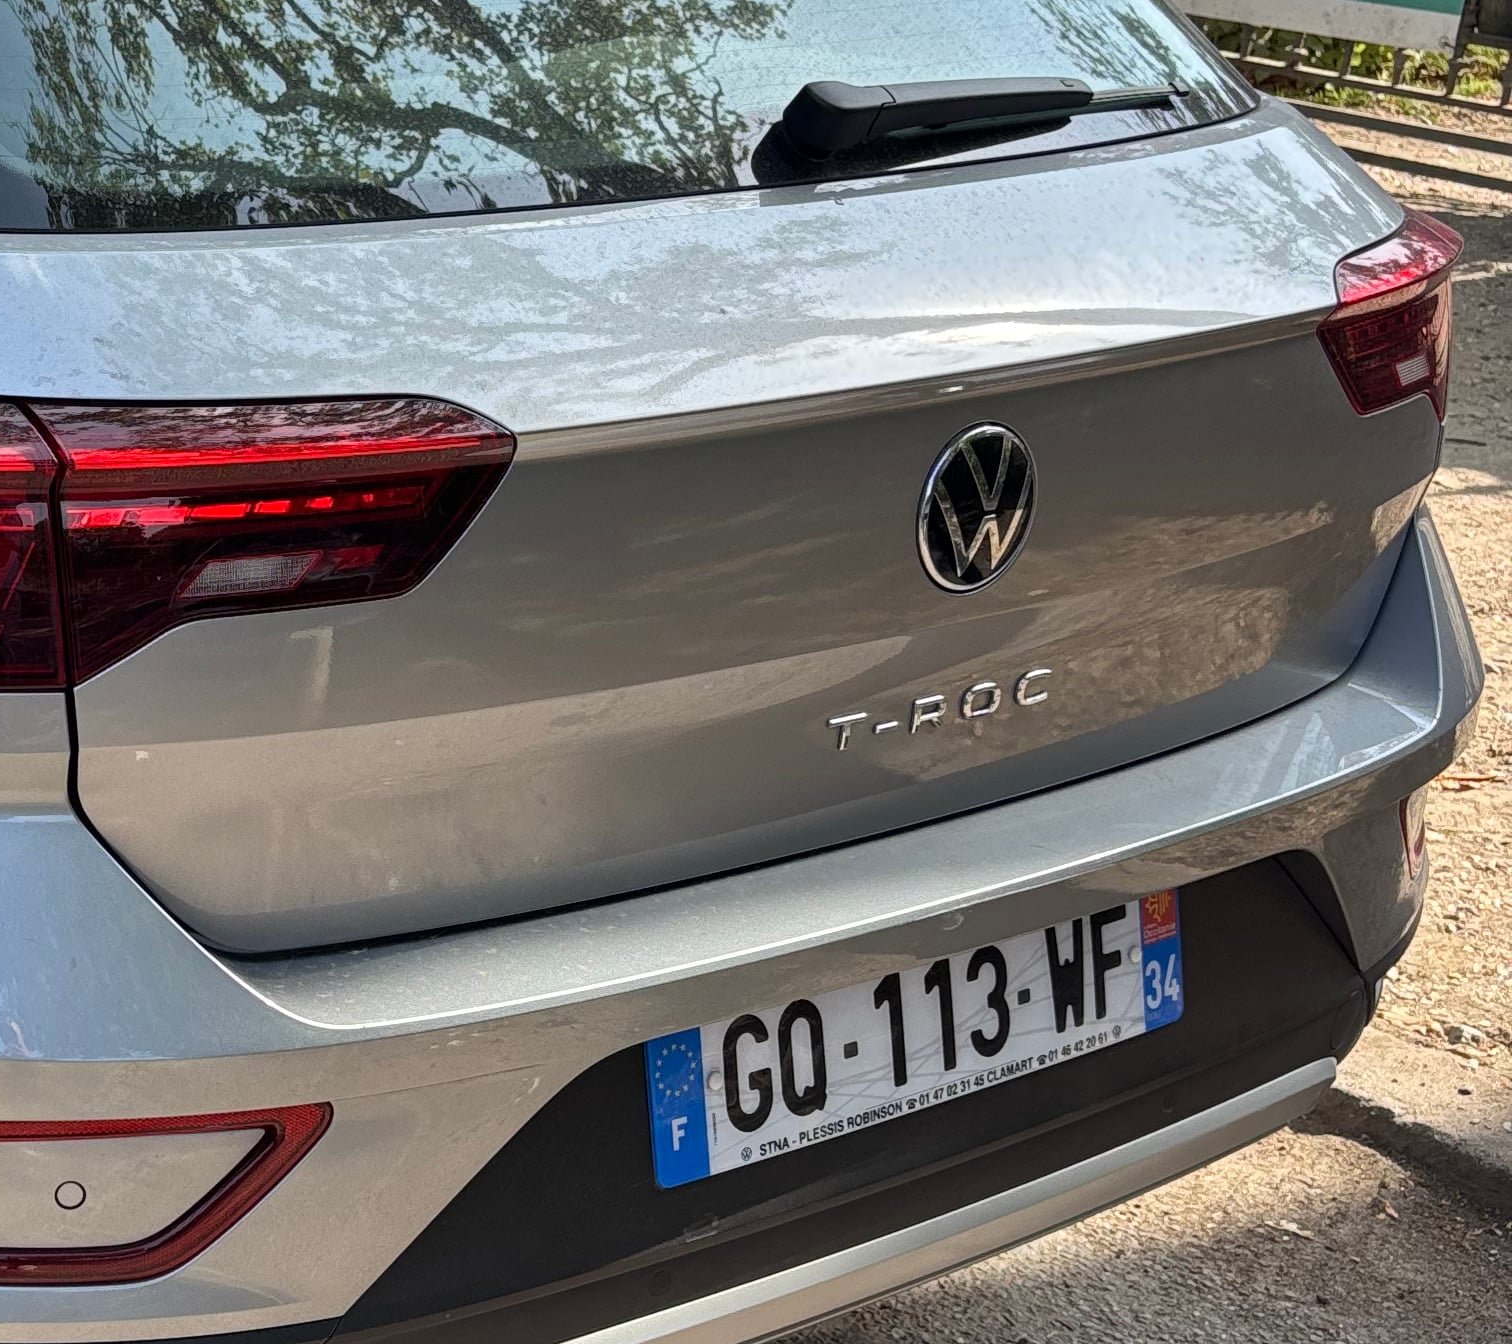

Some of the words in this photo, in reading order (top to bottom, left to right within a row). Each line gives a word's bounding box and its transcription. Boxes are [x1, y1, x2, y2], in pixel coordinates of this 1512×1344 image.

[827, 668, 1052, 751] T-ROC
[1145, 953, 1180, 1009] 34
[759, 1139, 790, 1156] STNA
[799, 1121, 844, 1145] PLESSIS
[846, 1101, 903, 1129] ROBINSON
[918, 1093, 930, 1106] 01
[932, 1087, 944, 1101] 47
[946, 1083, 958, 1097] 02
[960, 1078, 971, 1092] 31
[987, 1056, 1034, 1083] CLAMART
[1048, 1048, 1058, 1062] 01
[1073, 1040, 1084, 1053] 42
[1085, 1035, 1097, 1048] 20
[671, 1116, 687, 1151] F
